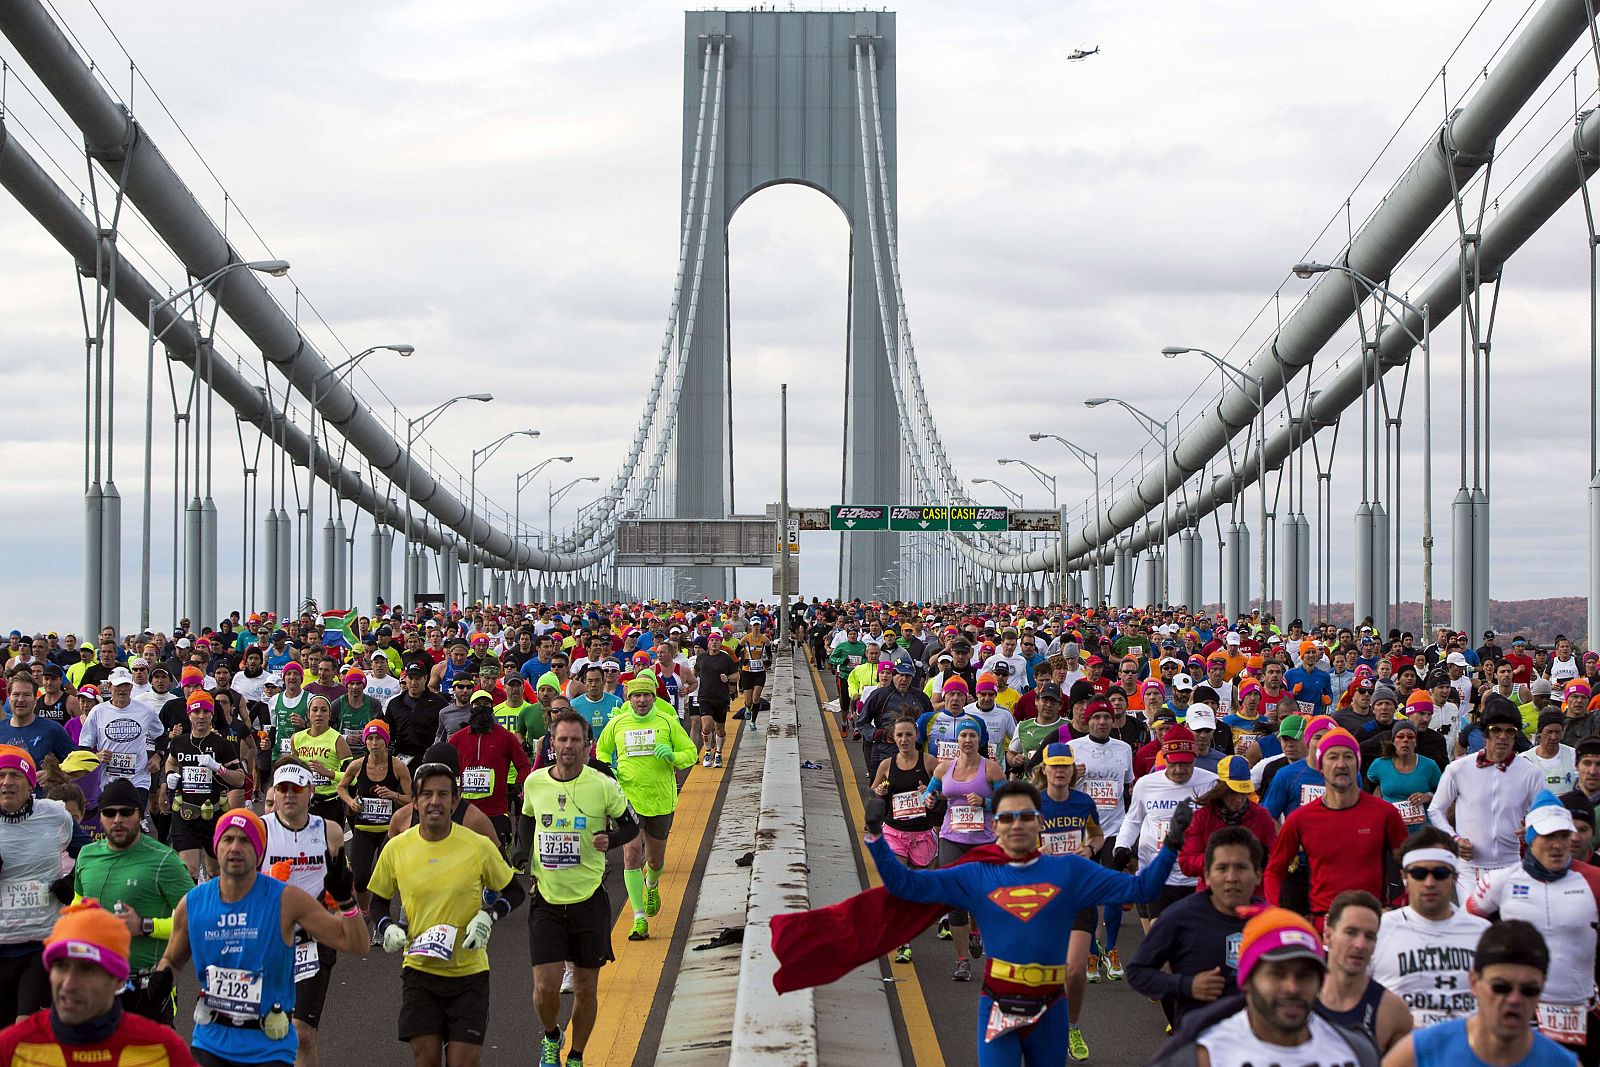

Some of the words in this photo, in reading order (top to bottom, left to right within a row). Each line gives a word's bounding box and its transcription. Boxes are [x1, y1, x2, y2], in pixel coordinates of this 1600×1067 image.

[922, 507, 947, 520] CASH
[951, 507, 976, 520] CASH
[45, 710, 64, 718] NBR
[106, 726, 141, 734] TRIATHLON
[633, 735, 646, 744] 739
[177, 752, 216, 762] Danl
[113, 759, 131, 768] 8-621
[187, 773, 207, 782] 4-672
[467, 777, 486, 786] 4-072
[1090, 787, 1114, 797] 13-574
[1310, 787, 1325, 795] ING
[899, 797, 919, 808] 2-614
[366, 804, 388, 814] 10-677
[960, 813, 974, 822] 239
[545, 842, 574, 854] 37-151
[1051, 840, 1076, 852] 11-721
[269, 854, 324, 866] IRONMAN
[7, 884, 28, 893] ING
[9, 892, 40, 907] 7-301
[217, 912, 247, 927] JOE
[204, 930, 220, 938] ING
[215, 970, 237, 980] ING
[216, 979, 249, 999] 7-128
[1547, 1006, 1569, 1014] ING
[1547, 1014, 1578, 1030] 11-110
